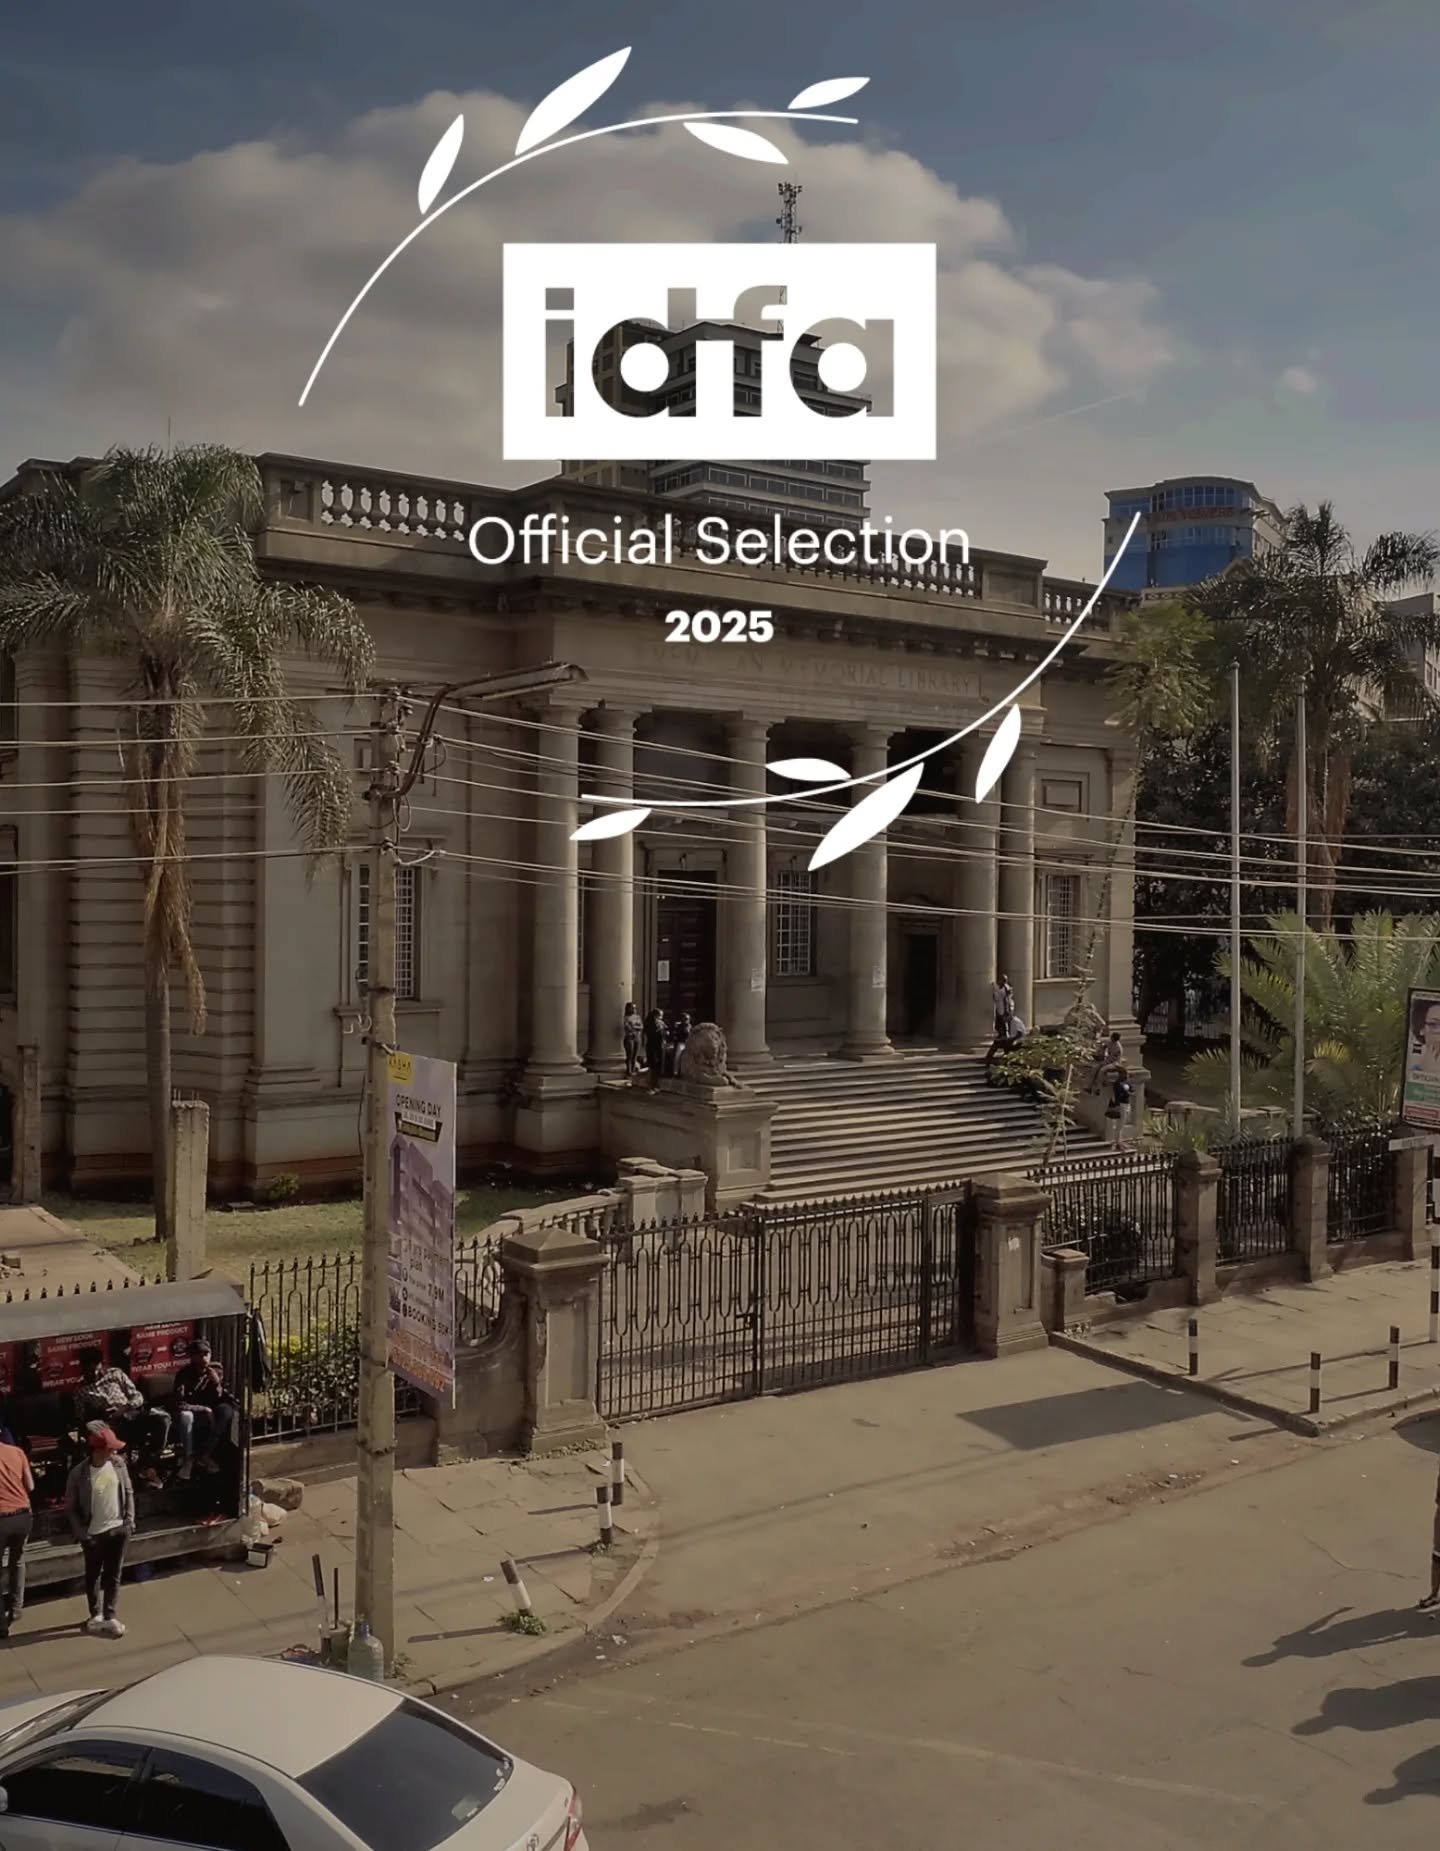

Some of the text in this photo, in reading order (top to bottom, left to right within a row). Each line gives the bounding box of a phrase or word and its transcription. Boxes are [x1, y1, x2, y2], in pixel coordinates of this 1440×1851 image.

[396, 1094, 426, 1114] OPENING
[427, 1102, 442, 1119] DAY
[408, 1305, 436, 1331] BOOKING
